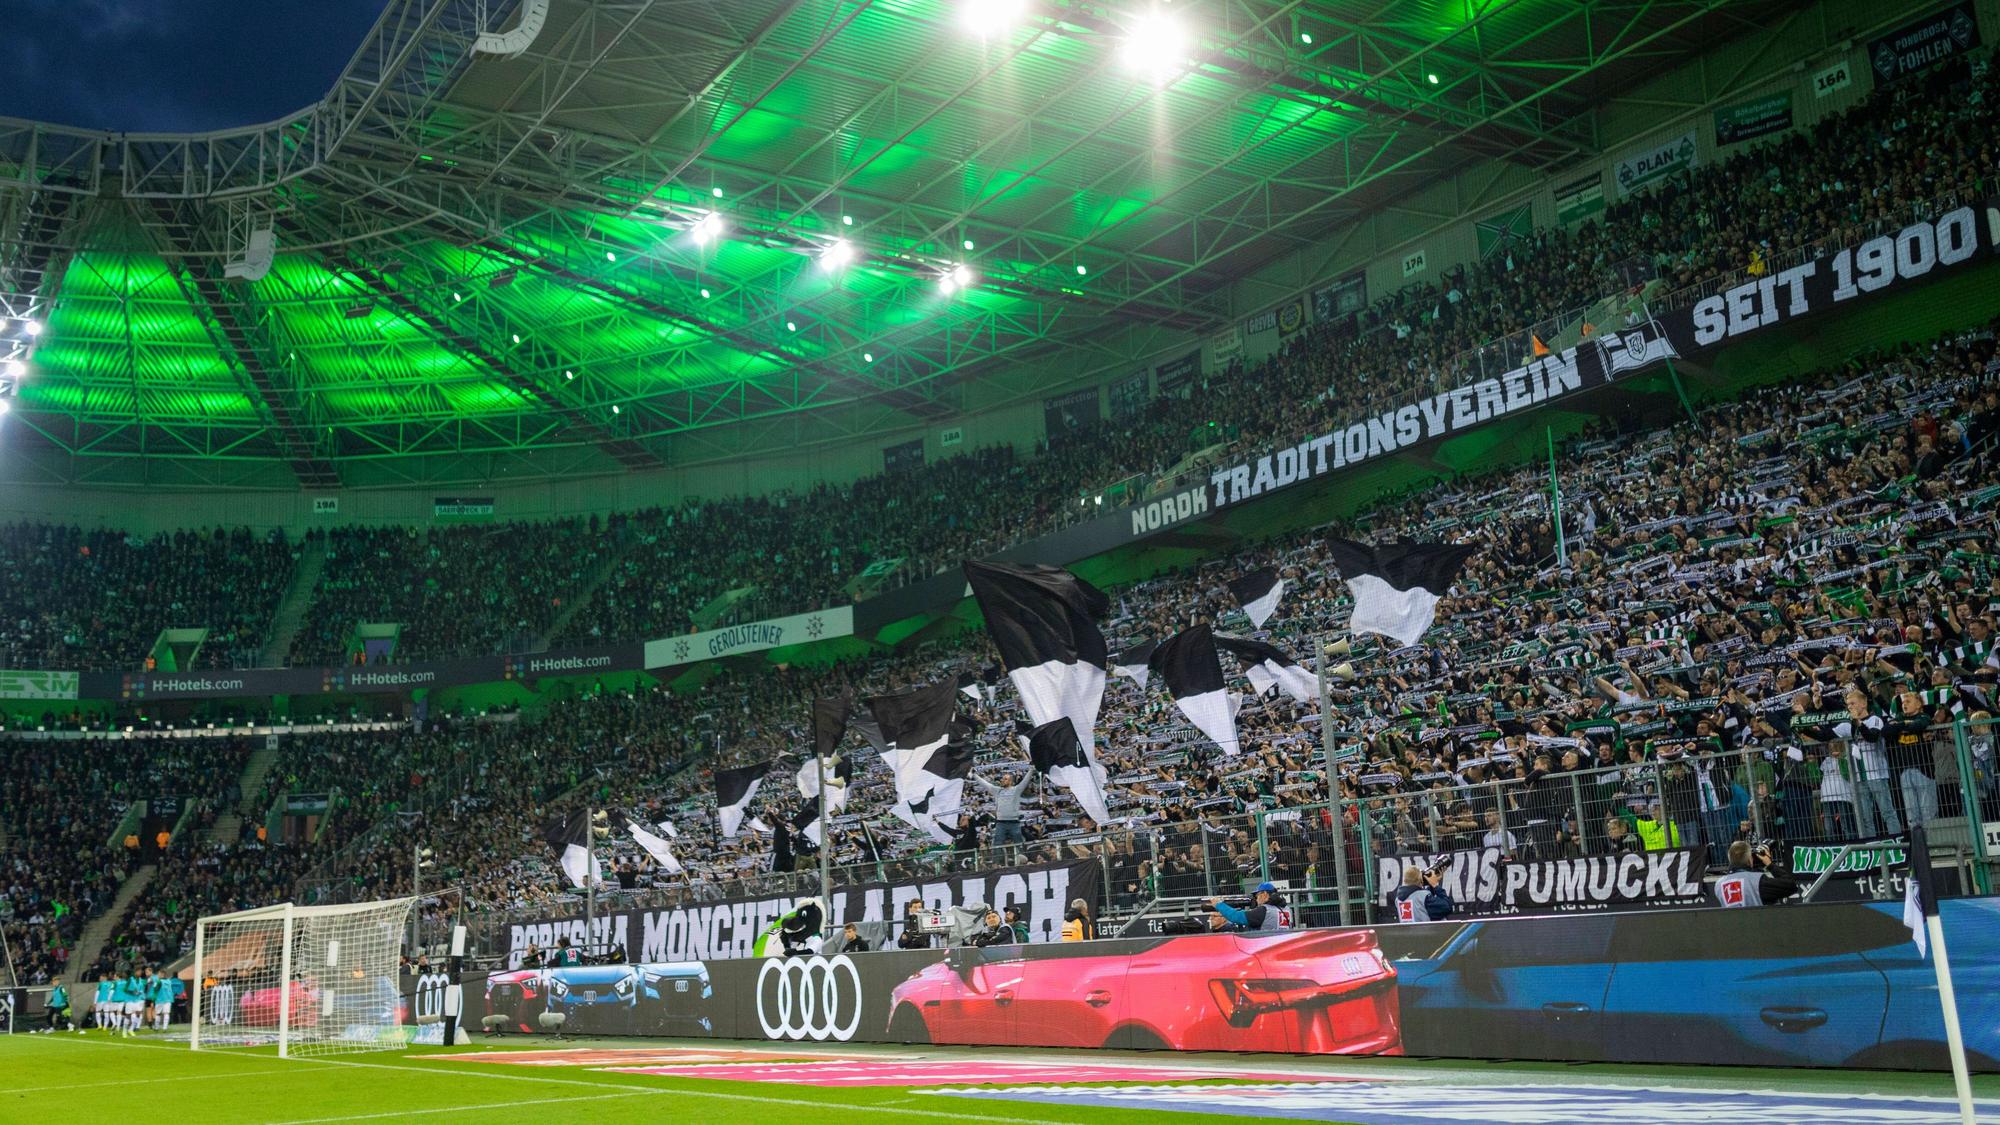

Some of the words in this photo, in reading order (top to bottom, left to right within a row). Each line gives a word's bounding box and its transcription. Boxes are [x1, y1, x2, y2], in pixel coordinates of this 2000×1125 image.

[1895, 19, 1948, 52] PONDEROSA
[1898, 36, 1953, 73] FOHLEN
[1817, 69, 1846, 90] 16A
[1637, 148, 1674, 175] PLAN
[1405, 256, 1423, 271] 17A
[1692, 260, 1816, 346] SEIT
[1832, 206, 1978, 303] 1900
[1131, 485, 1207, 535] NORDK
[1211, 347, 1581, 507] TRADITIONSVEREIN
[316, 501, 335, 509] 19A
[708, 624, 784, 656] GEROLSTEINER
[531, 655, 611, 671] H-Hotels.com
[152, 678, 243, 692] H-Hotels.com
[351, 668, 435, 685] H-Hotels.com
[1800, 714, 1826, 724] SEELE
[1506, 851, 1698, 905] PUMUCKL
[1855, 872, 1906, 895] flat
